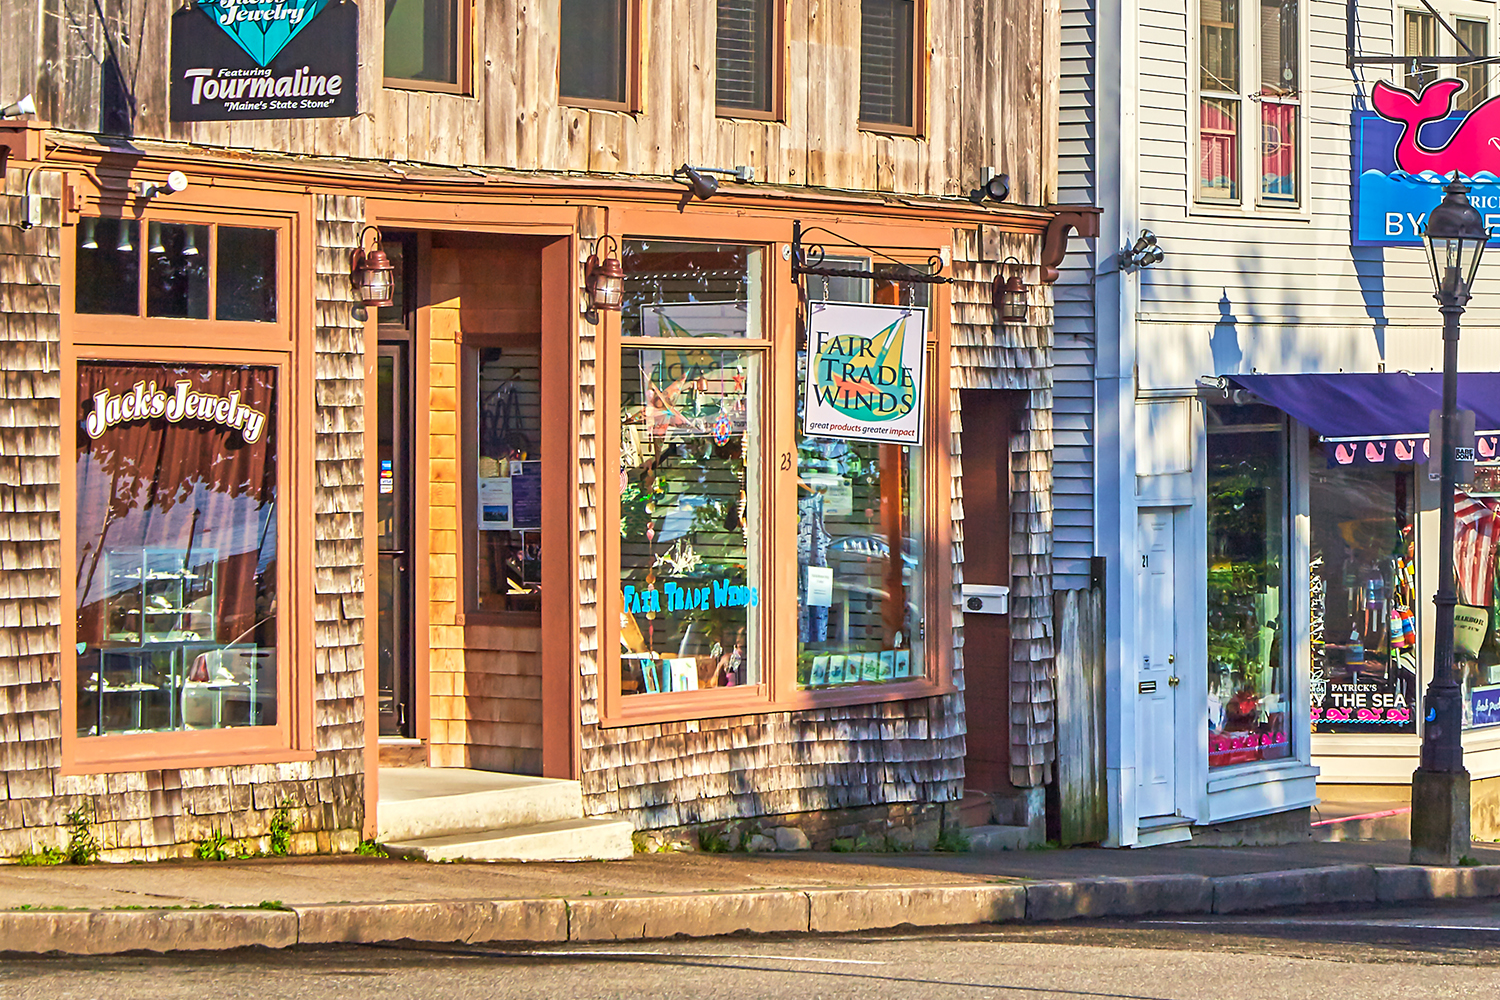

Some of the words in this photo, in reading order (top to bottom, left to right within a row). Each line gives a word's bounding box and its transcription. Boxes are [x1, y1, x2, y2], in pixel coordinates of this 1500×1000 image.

[220, 4, 304, 25] Jewelry
[218, 68, 272, 78] Featuring
[184, 66, 342, 104] Tourmaline
[269, 100, 298, 109] State
[300, 99, 334, 109] Stone"
[1385, 212, 1425, 236] BY
[816, 331, 877, 358] FAIR
[820, 358, 913, 387] TRADE
[813, 384, 912, 414] WINDS
[87, 380, 167, 439] Jack's
[166, 379, 266, 444] Jewelry
[809, 421, 829, 430] great
[829, 423, 861, 432] products
[862, 426, 888, 434] greater
[889, 427, 915, 436] impact
[780, 452, 792, 471] 23
[1142, 555, 1149, 568] 21
[1331, 684, 1377, 692] PATRICK'S
[1331, 693, 1366, 707] THE
[1372, 693, 1407, 707] SEA
